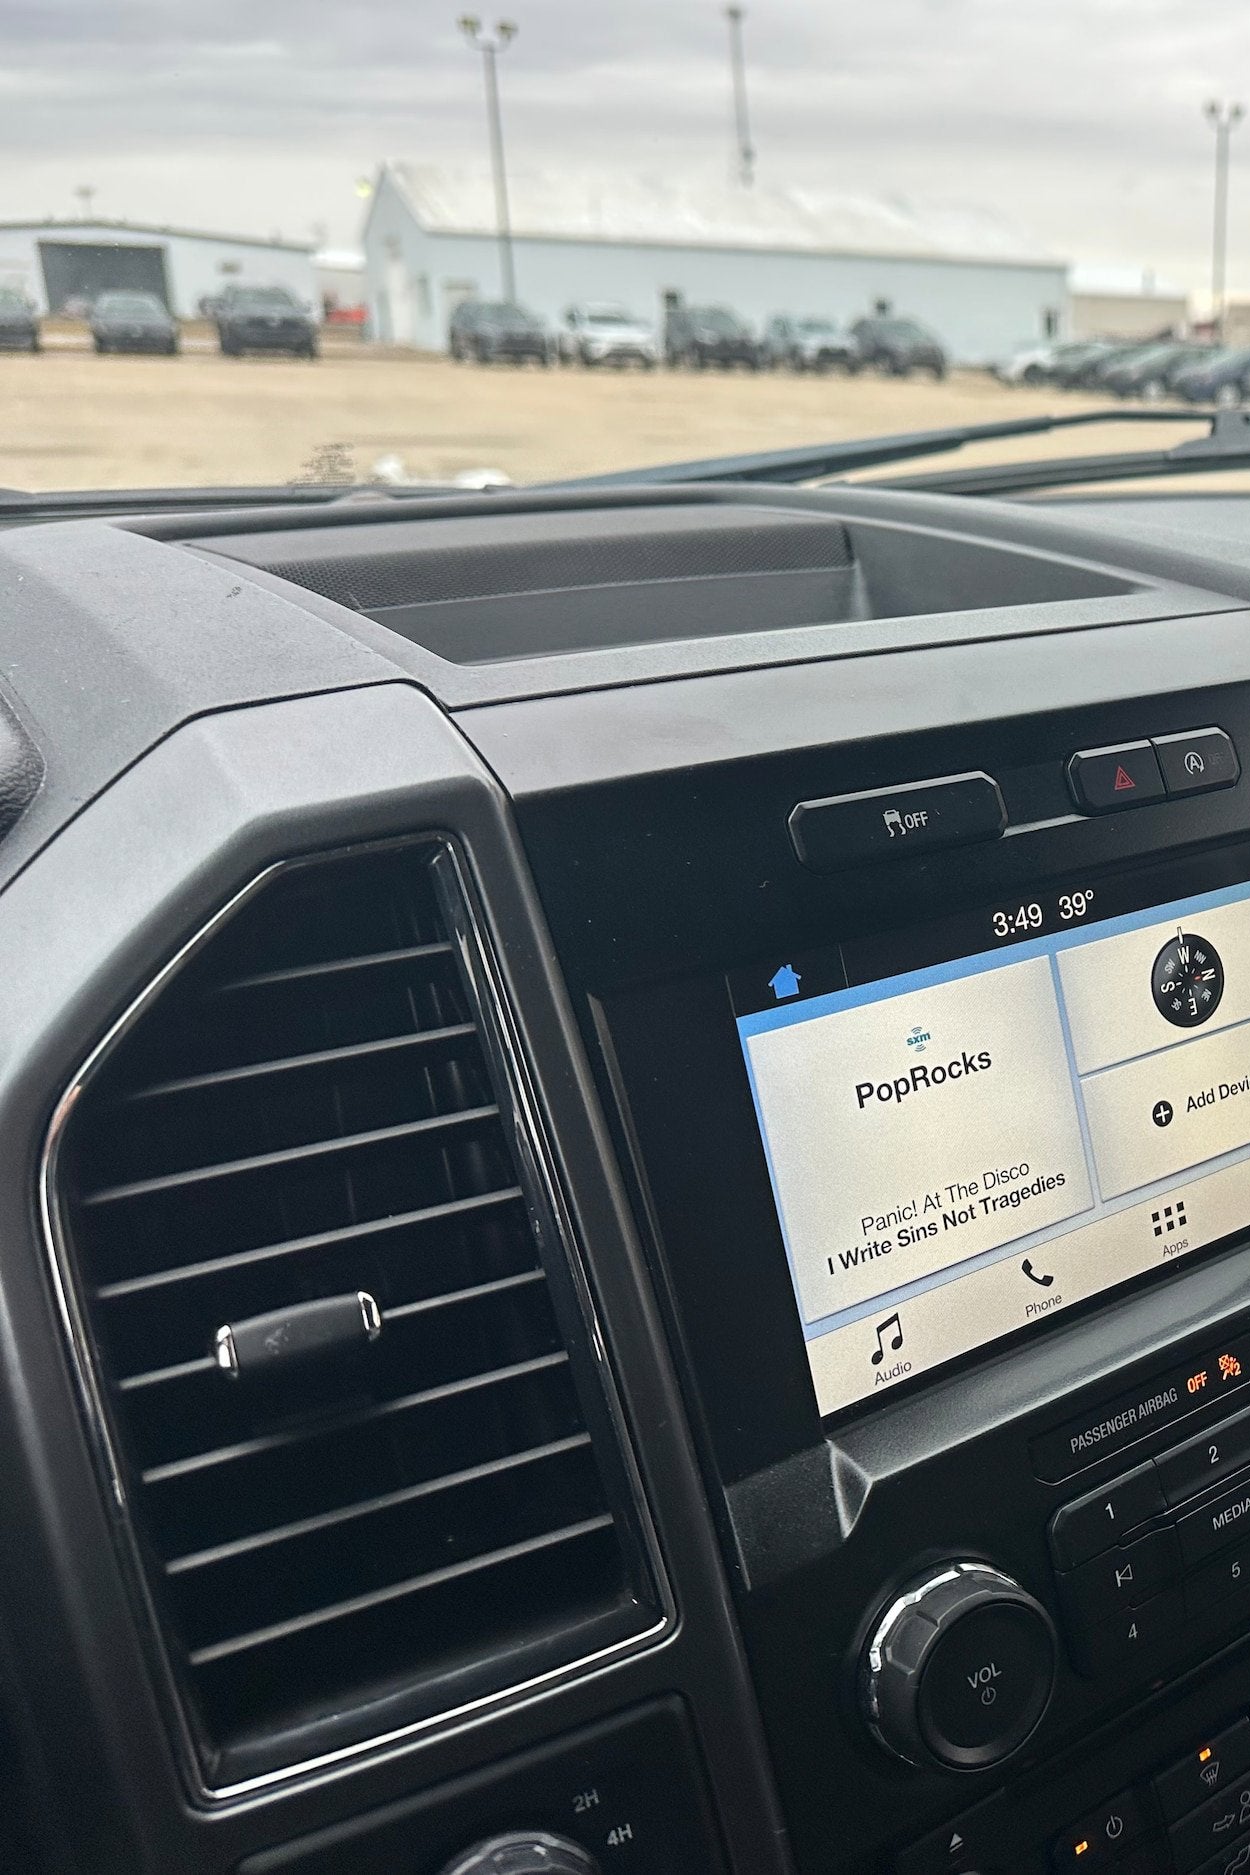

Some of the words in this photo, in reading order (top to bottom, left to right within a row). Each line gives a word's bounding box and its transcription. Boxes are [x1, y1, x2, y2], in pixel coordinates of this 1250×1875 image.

[903, 810, 929, 830] OFF
[992, 903, 1043, 937] 3:49
[1058, 890, 1094, 920] 39°
[1177, 945, 1190, 965] W
[1201, 968, 1216, 982] N
[1160, 981, 1176, 994] S
[1188, 998, 1198, 1016] E
[906, 1031, 931, 1046] sxm
[855, 1051, 992, 1109] PopRocks
[1186, 1088, 1216, 1112] Add
[861, 1200, 918, 1236] Panic!
[923, 1192, 942, 1214] At
[944, 1180, 980, 1204] The
[982, 1162, 1030, 1190] Disco
[827, 1257, 835, 1275] I
[838, 1237, 893, 1270] Write
[896, 1222, 938, 1247] Sins
[942, 1204, 977, 1230] Not
[978, 1173, 1066, 1215] Tragedies
[1162, 1238, 1189, 1258] Apps
[1024, 1294, 1062, 1318] Phone
[874, 1360, 912, 1386] Audio
[1070, 1408, 1138, 1454] PASSENGER
[1138, 1387, 1178, 1420] AIRBAG
[1186, 1370, 1208, 1394] OFF
[1208, 1446, 1219, 1464] 2
[1104, 1502, 1116, 1520] 1
[1231, 1561, 1242, 1578] 5
[1128, 1623, 1138, 1639] 4
[968, 1662, 1002, 1688] VOL
[572, 1788, 600, 1814] 2H
[606, 1823, 634, 1847] 4H
